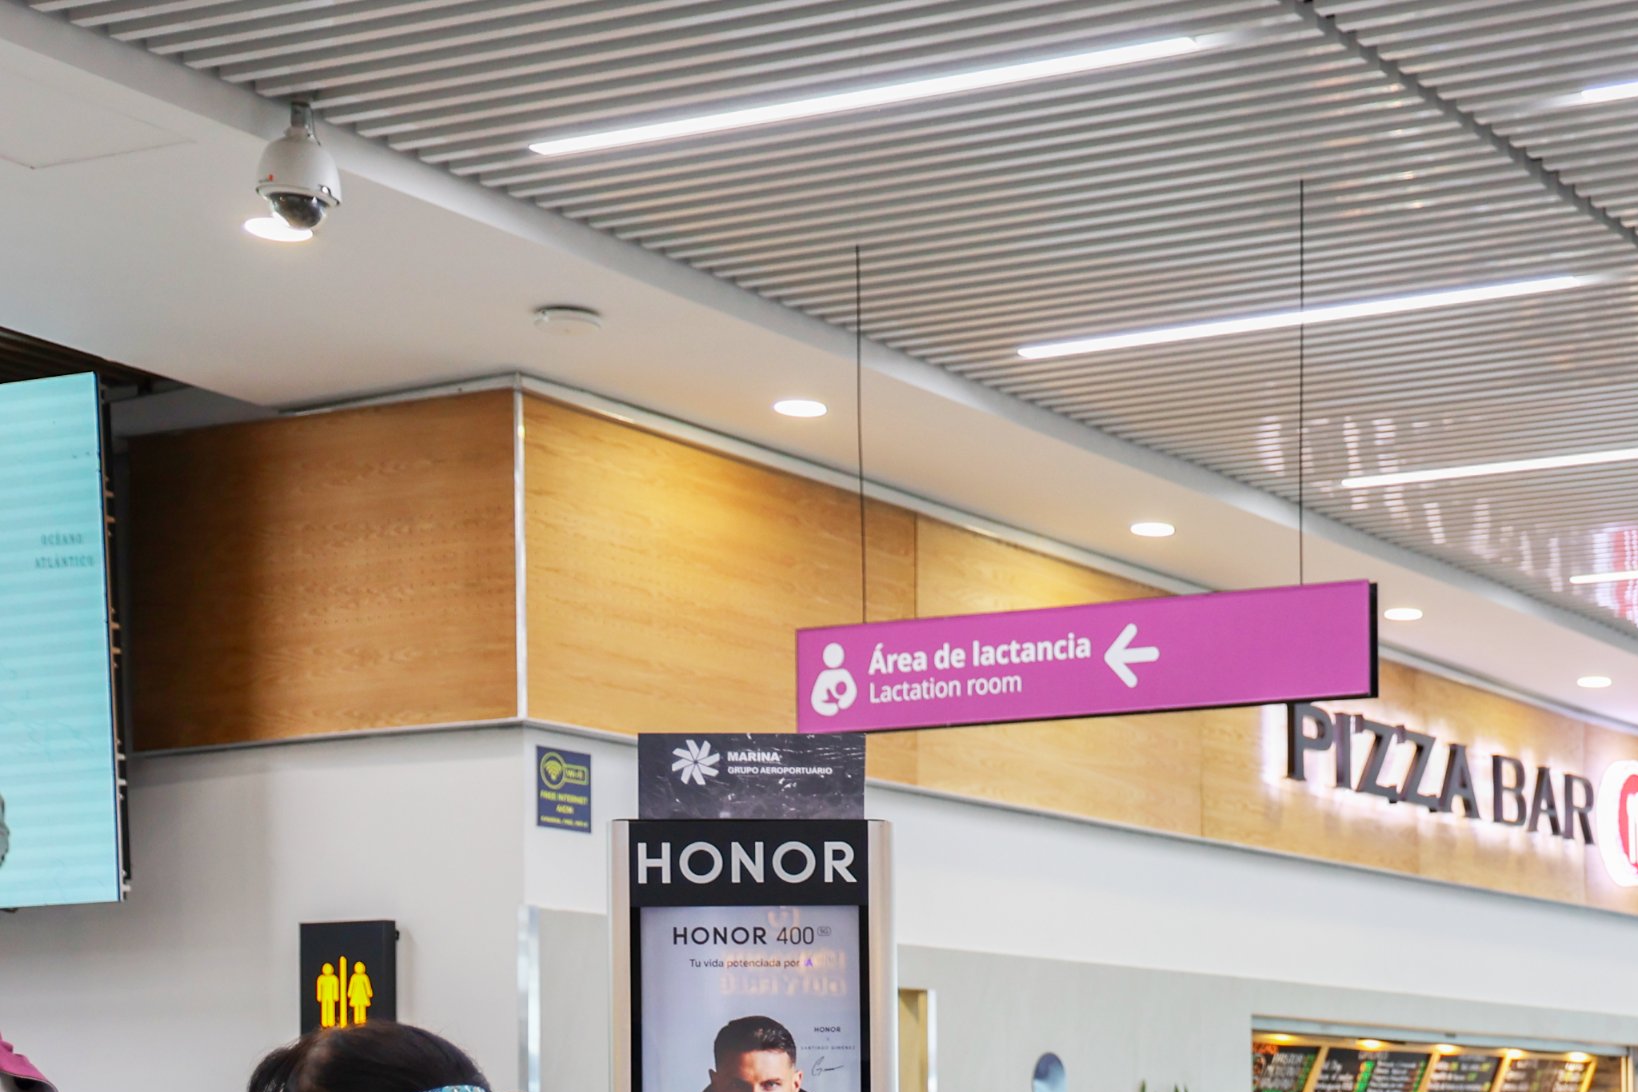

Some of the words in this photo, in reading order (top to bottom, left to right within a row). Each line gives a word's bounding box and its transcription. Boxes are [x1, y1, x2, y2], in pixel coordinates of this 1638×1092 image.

[869, 642, 927, 675] Área
[934, 642, 966, 670] de
[972, 633, 1092, 666] lactancia
[869, 678, 962, 704] Lactation
[967, 675, 1022, 699] room
[727, 752, 780, 762] MARINA
[728, 766, 759, 775] GRUPO
[760, 766, 833, 775] AEROPORTUARIO
[1287, 702, 1480, 819] PIZZA
[1492, 754, 1595, 845] BAR
[637, 841, 858, 884] HONOR
[673, 926, 767, 945] HONOR
[776, 927, 815, 945] 400
[690, 959, 701, 968] Tu
[704, 959, 724, 968] vida
[726, 959, 781, 970] potenciada
[784, 961, 800, 970] por
